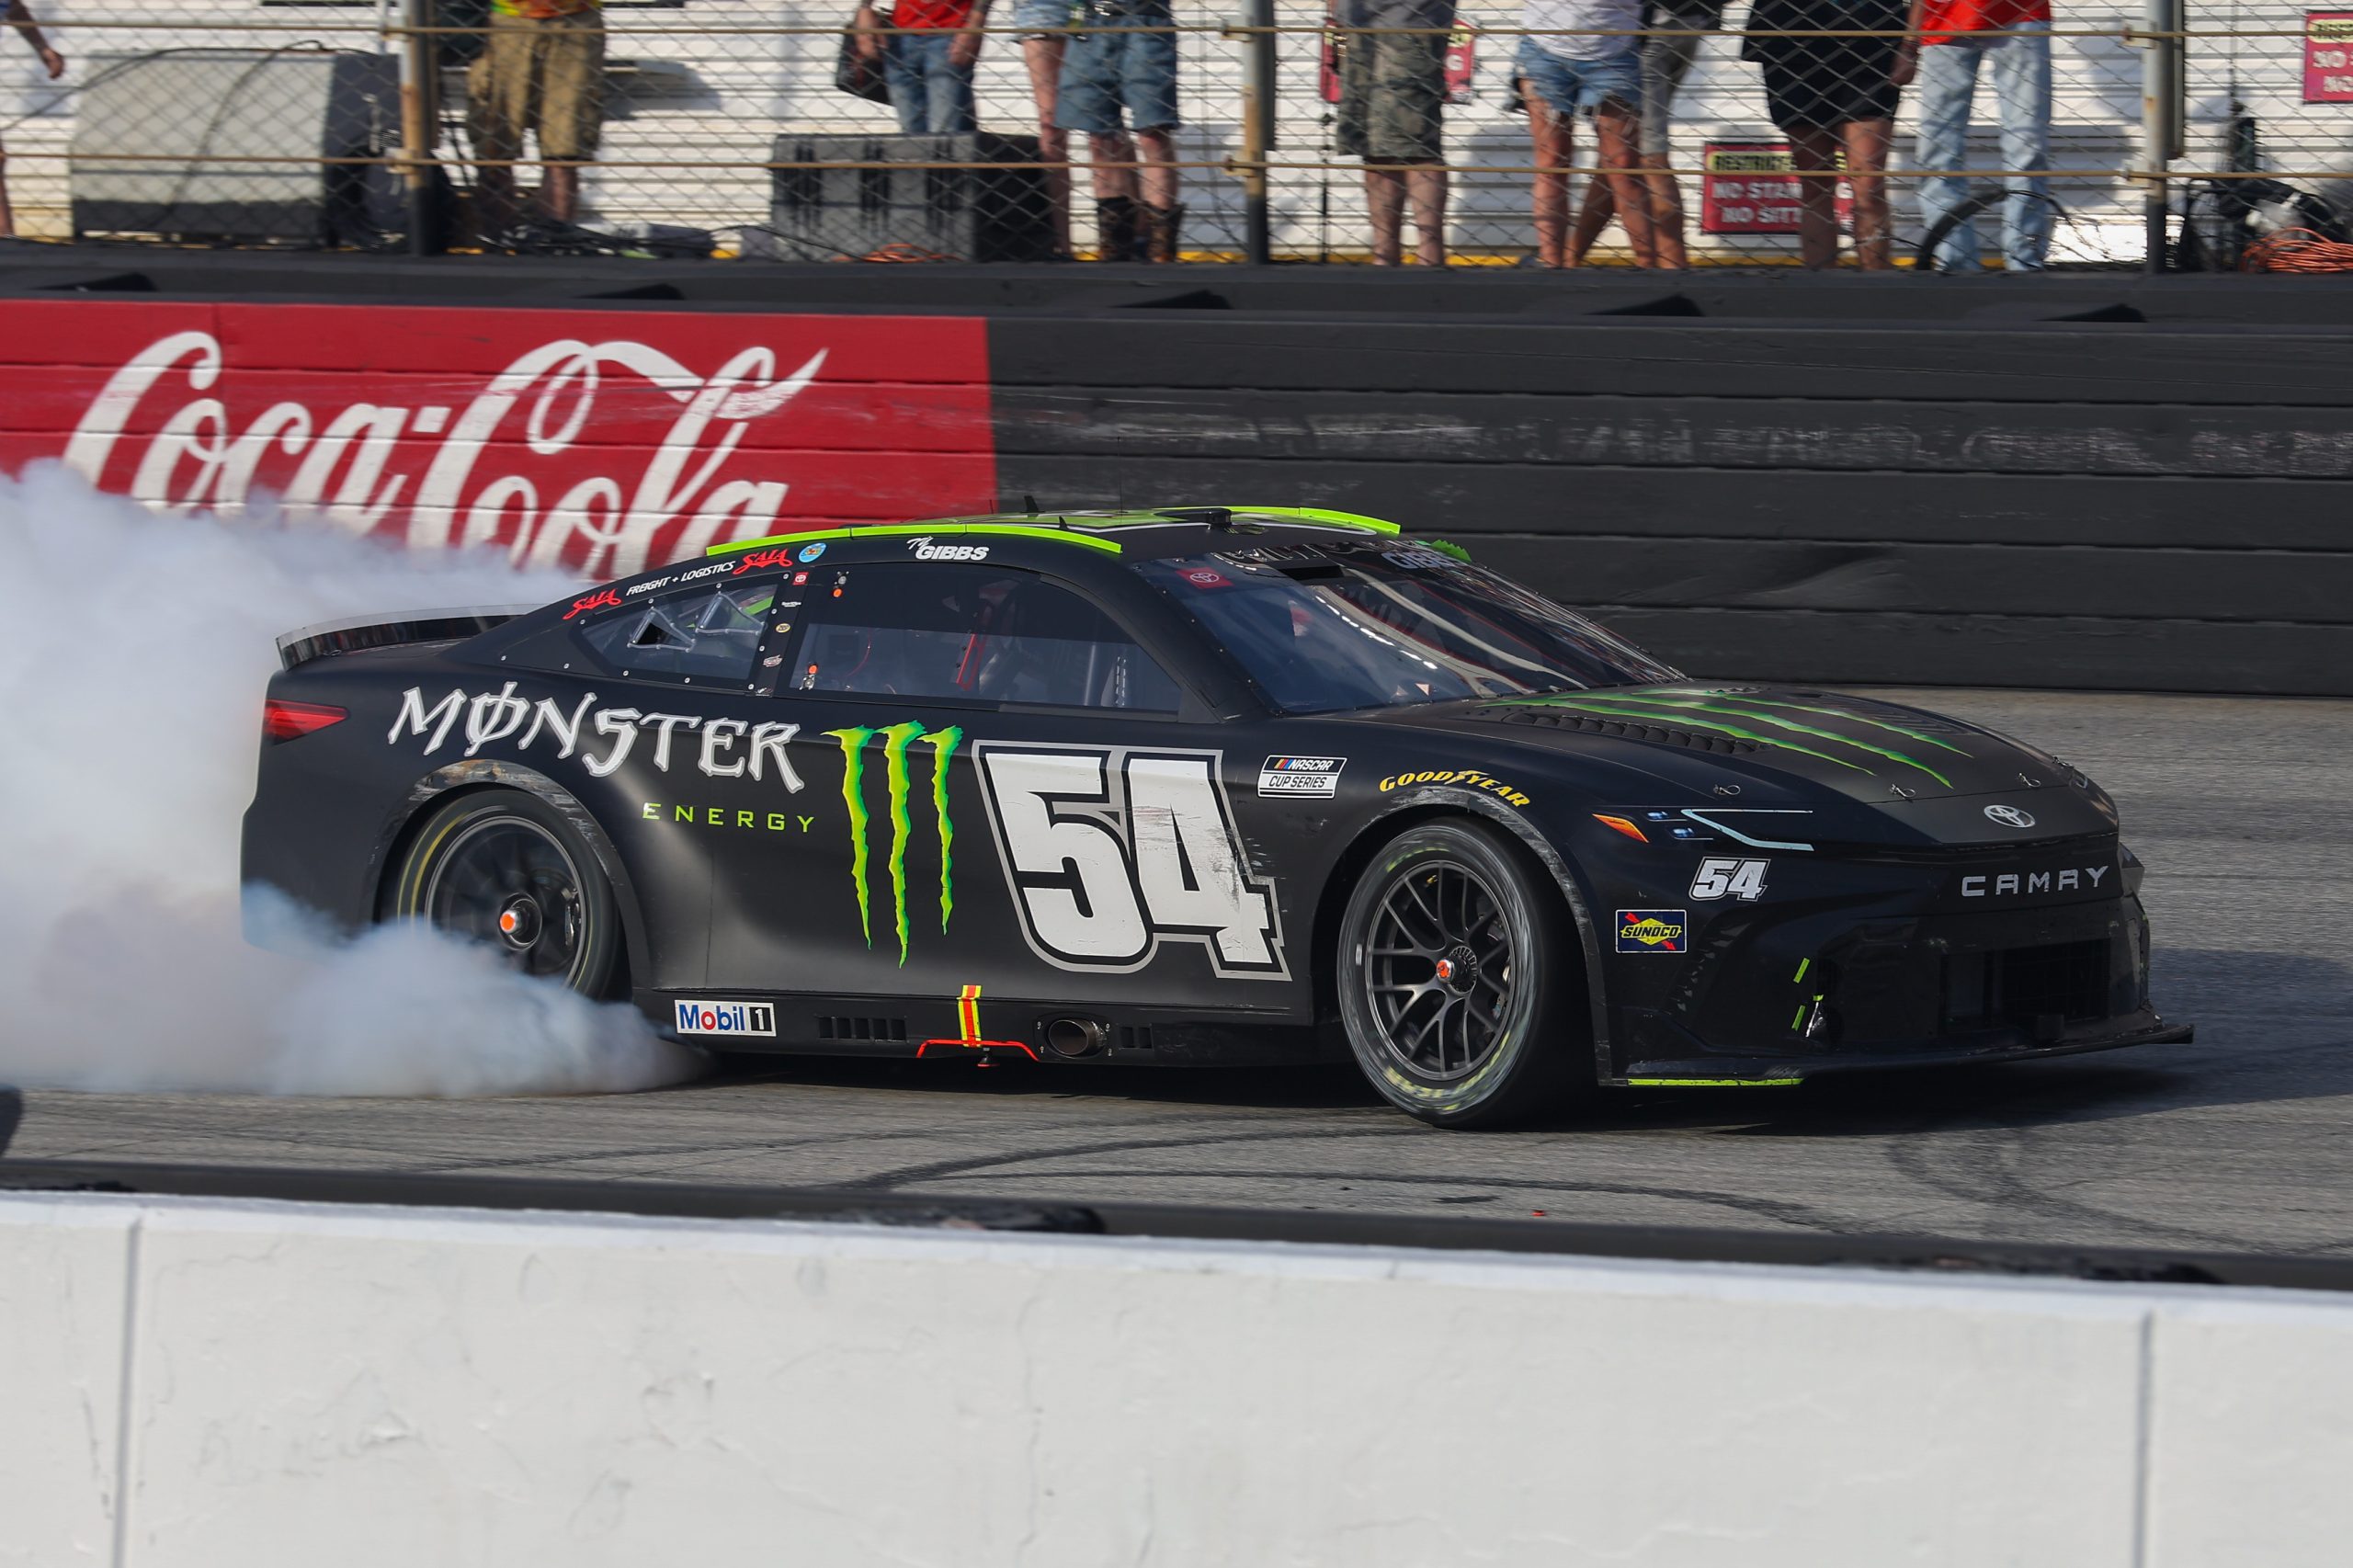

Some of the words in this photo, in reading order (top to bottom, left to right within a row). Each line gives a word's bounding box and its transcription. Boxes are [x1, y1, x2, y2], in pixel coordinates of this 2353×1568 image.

[1712, 182, 1745, 199] NO
[1722, 207, 1755, 223] NO
[63, 330, 829, 582] Coca-Cola
[915, 545, 990, 561] GIBBS
[626, 576, 671, 597] FREIGHT
[680, 561, 736, 582] LOGISTICS
[1287, 758, 1335, 771] NASCAR
[1269, 776, 1290, 788] CUP
[1290, 777, 1327, 789] SERIES
[1379, 769, 1530, 808] GOODYEAR
[642, 802, 817, 834] ENERGY
[972, 739, 1292, 981] 54
[1688, 857, 1771, 902] 54
[1961, 865, 2109, 897] CAMRY
[1622, 926, 1681, 937] SUNOCO
[678, 1004, 745, 1031] Mobil
